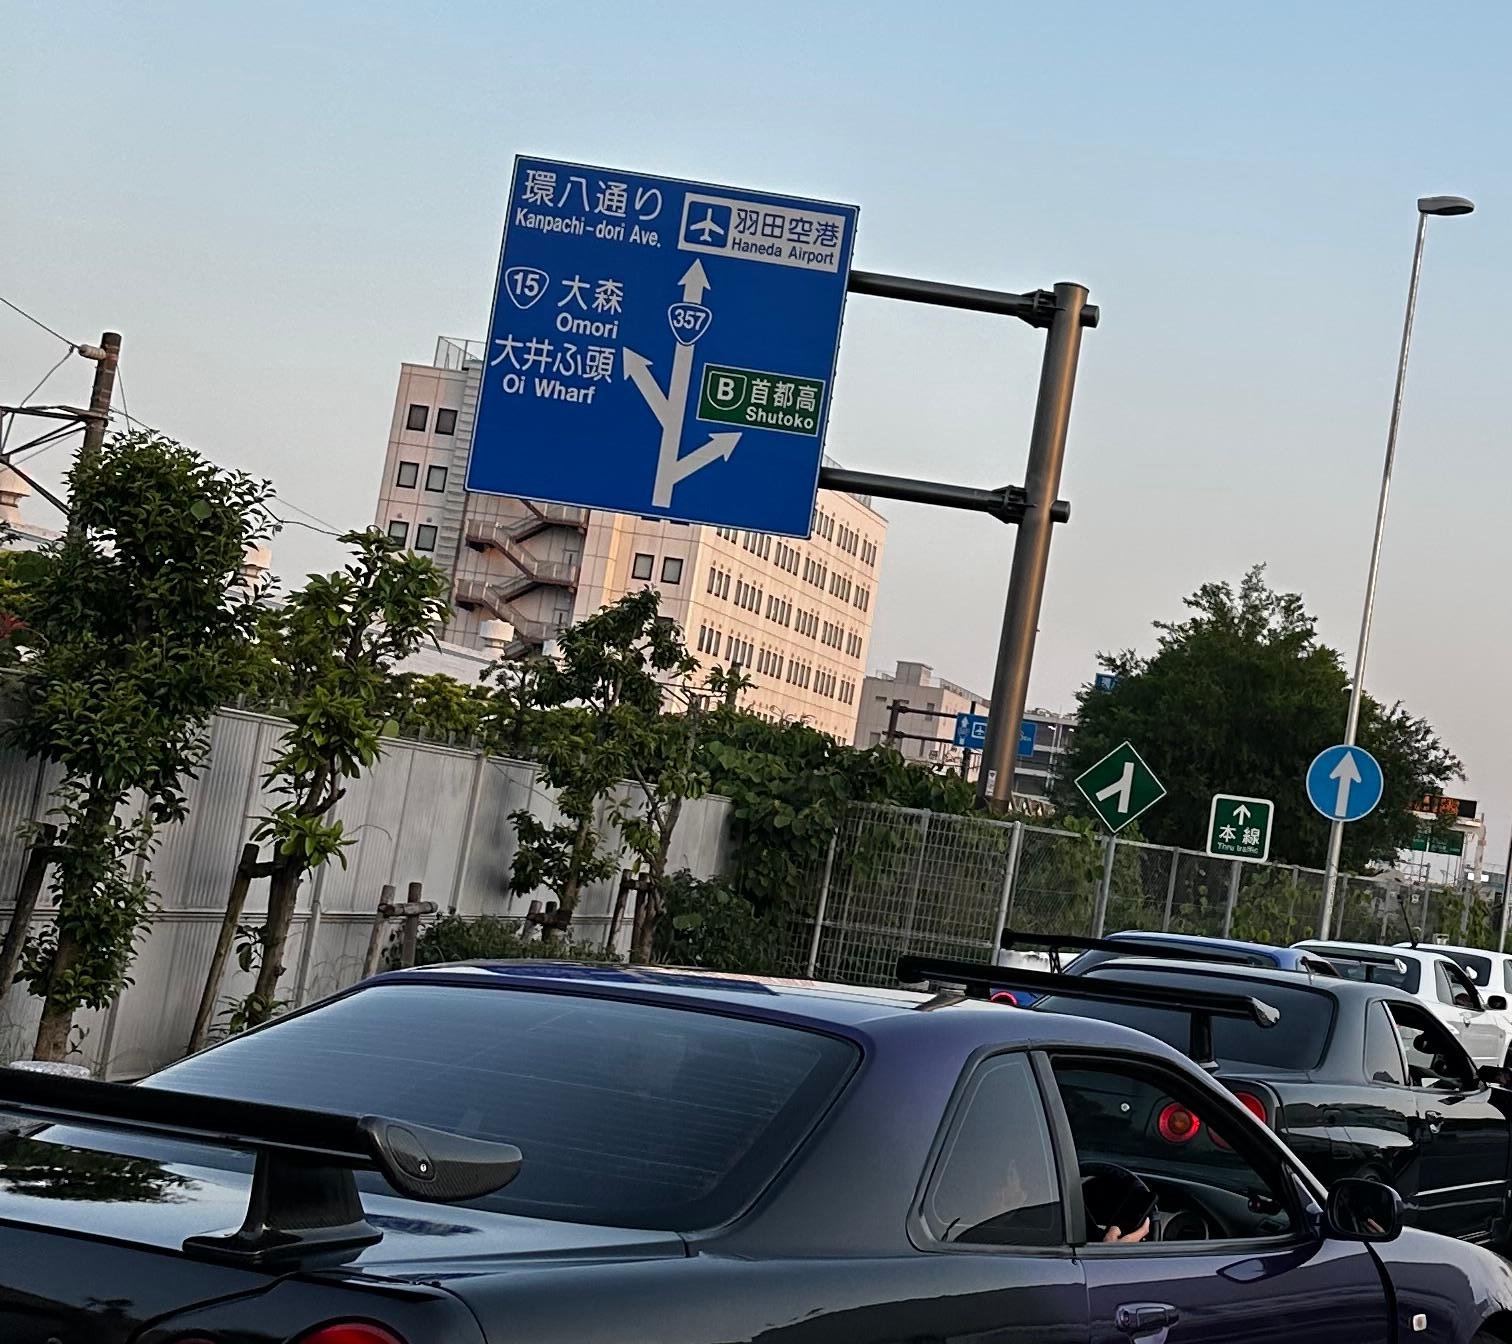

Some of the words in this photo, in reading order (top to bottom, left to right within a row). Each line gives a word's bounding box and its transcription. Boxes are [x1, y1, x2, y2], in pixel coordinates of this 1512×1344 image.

[521, 169, 663, 221] 環八通り
[515, 207, 626, 242] Kanpachi-dori
[628, 224, 661, 249] Ave.
[734, 208, 840, 248] 羽田空港
[731, 237, 783, 258] Haneda
[787, 246, 834, 265] Airport
[513, 271, 540, 297] 15
[557, 274, 624, 316] 大森
[556, 312, 619, 339] Omori
[672, 308, 706, 331] 357
[490, 334, 616, 384] 大井ふ頭
[502, 373, 526, 395] Oi
[534, 377, 596, 404] Wharf
[716, 376, 735, 402] B
[750, 378, 818, 413] 首都高
[745, 406, 814, 430] Shutoko
[1218, 823, 1260, 846] 本線
